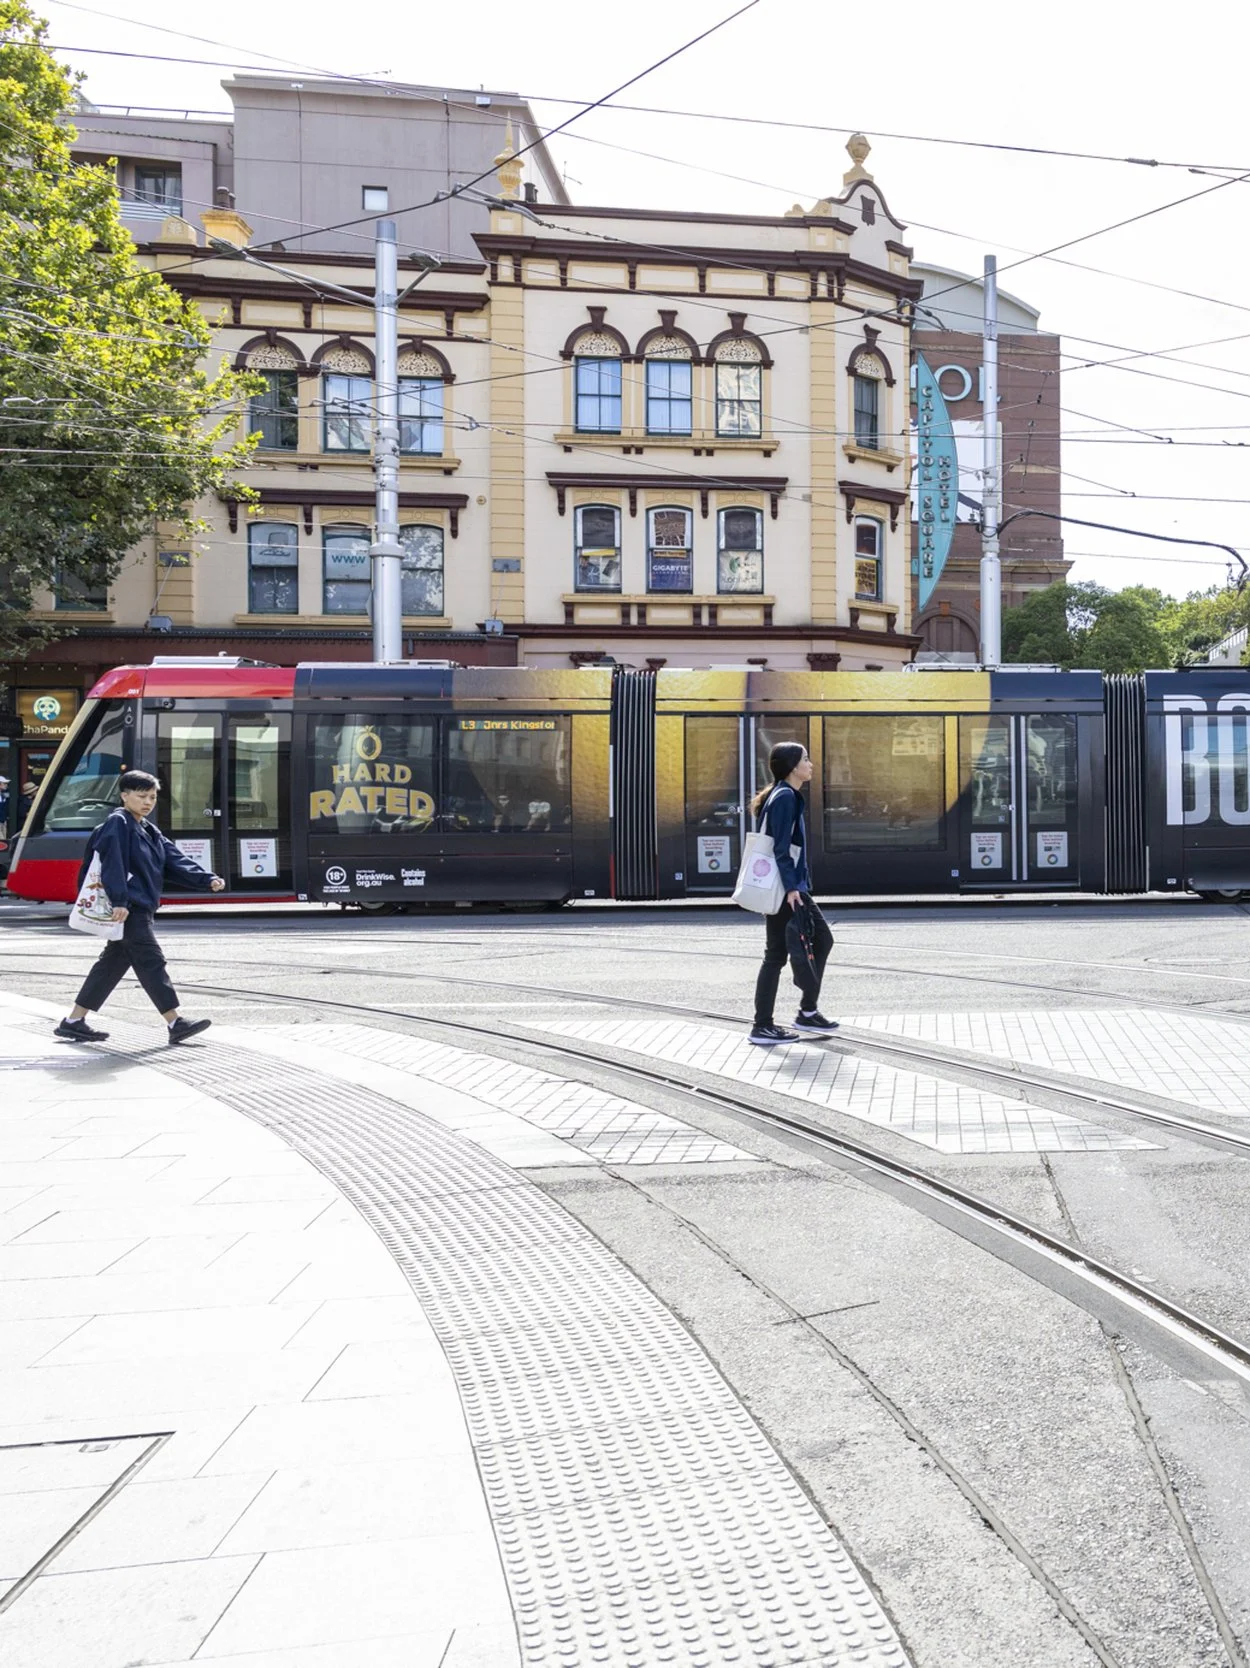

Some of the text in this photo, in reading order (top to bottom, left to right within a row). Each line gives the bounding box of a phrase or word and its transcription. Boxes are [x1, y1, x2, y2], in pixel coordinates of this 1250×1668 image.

[921, 386, 935, 579] CAPITOL SQUARE
[938, 456, 951, 523] HOTEL
[652, 564, 688, 572] GIGABYTE
[22, 724, 71, 734] ChaPand
[461, 720, 476, 730] L3
[483, 720, 508, 730] Jnrs
[332, 763, 412, 785] HARD
[309, 786, 436, 820] RATED
[328, 871, 344, 881] 18+
